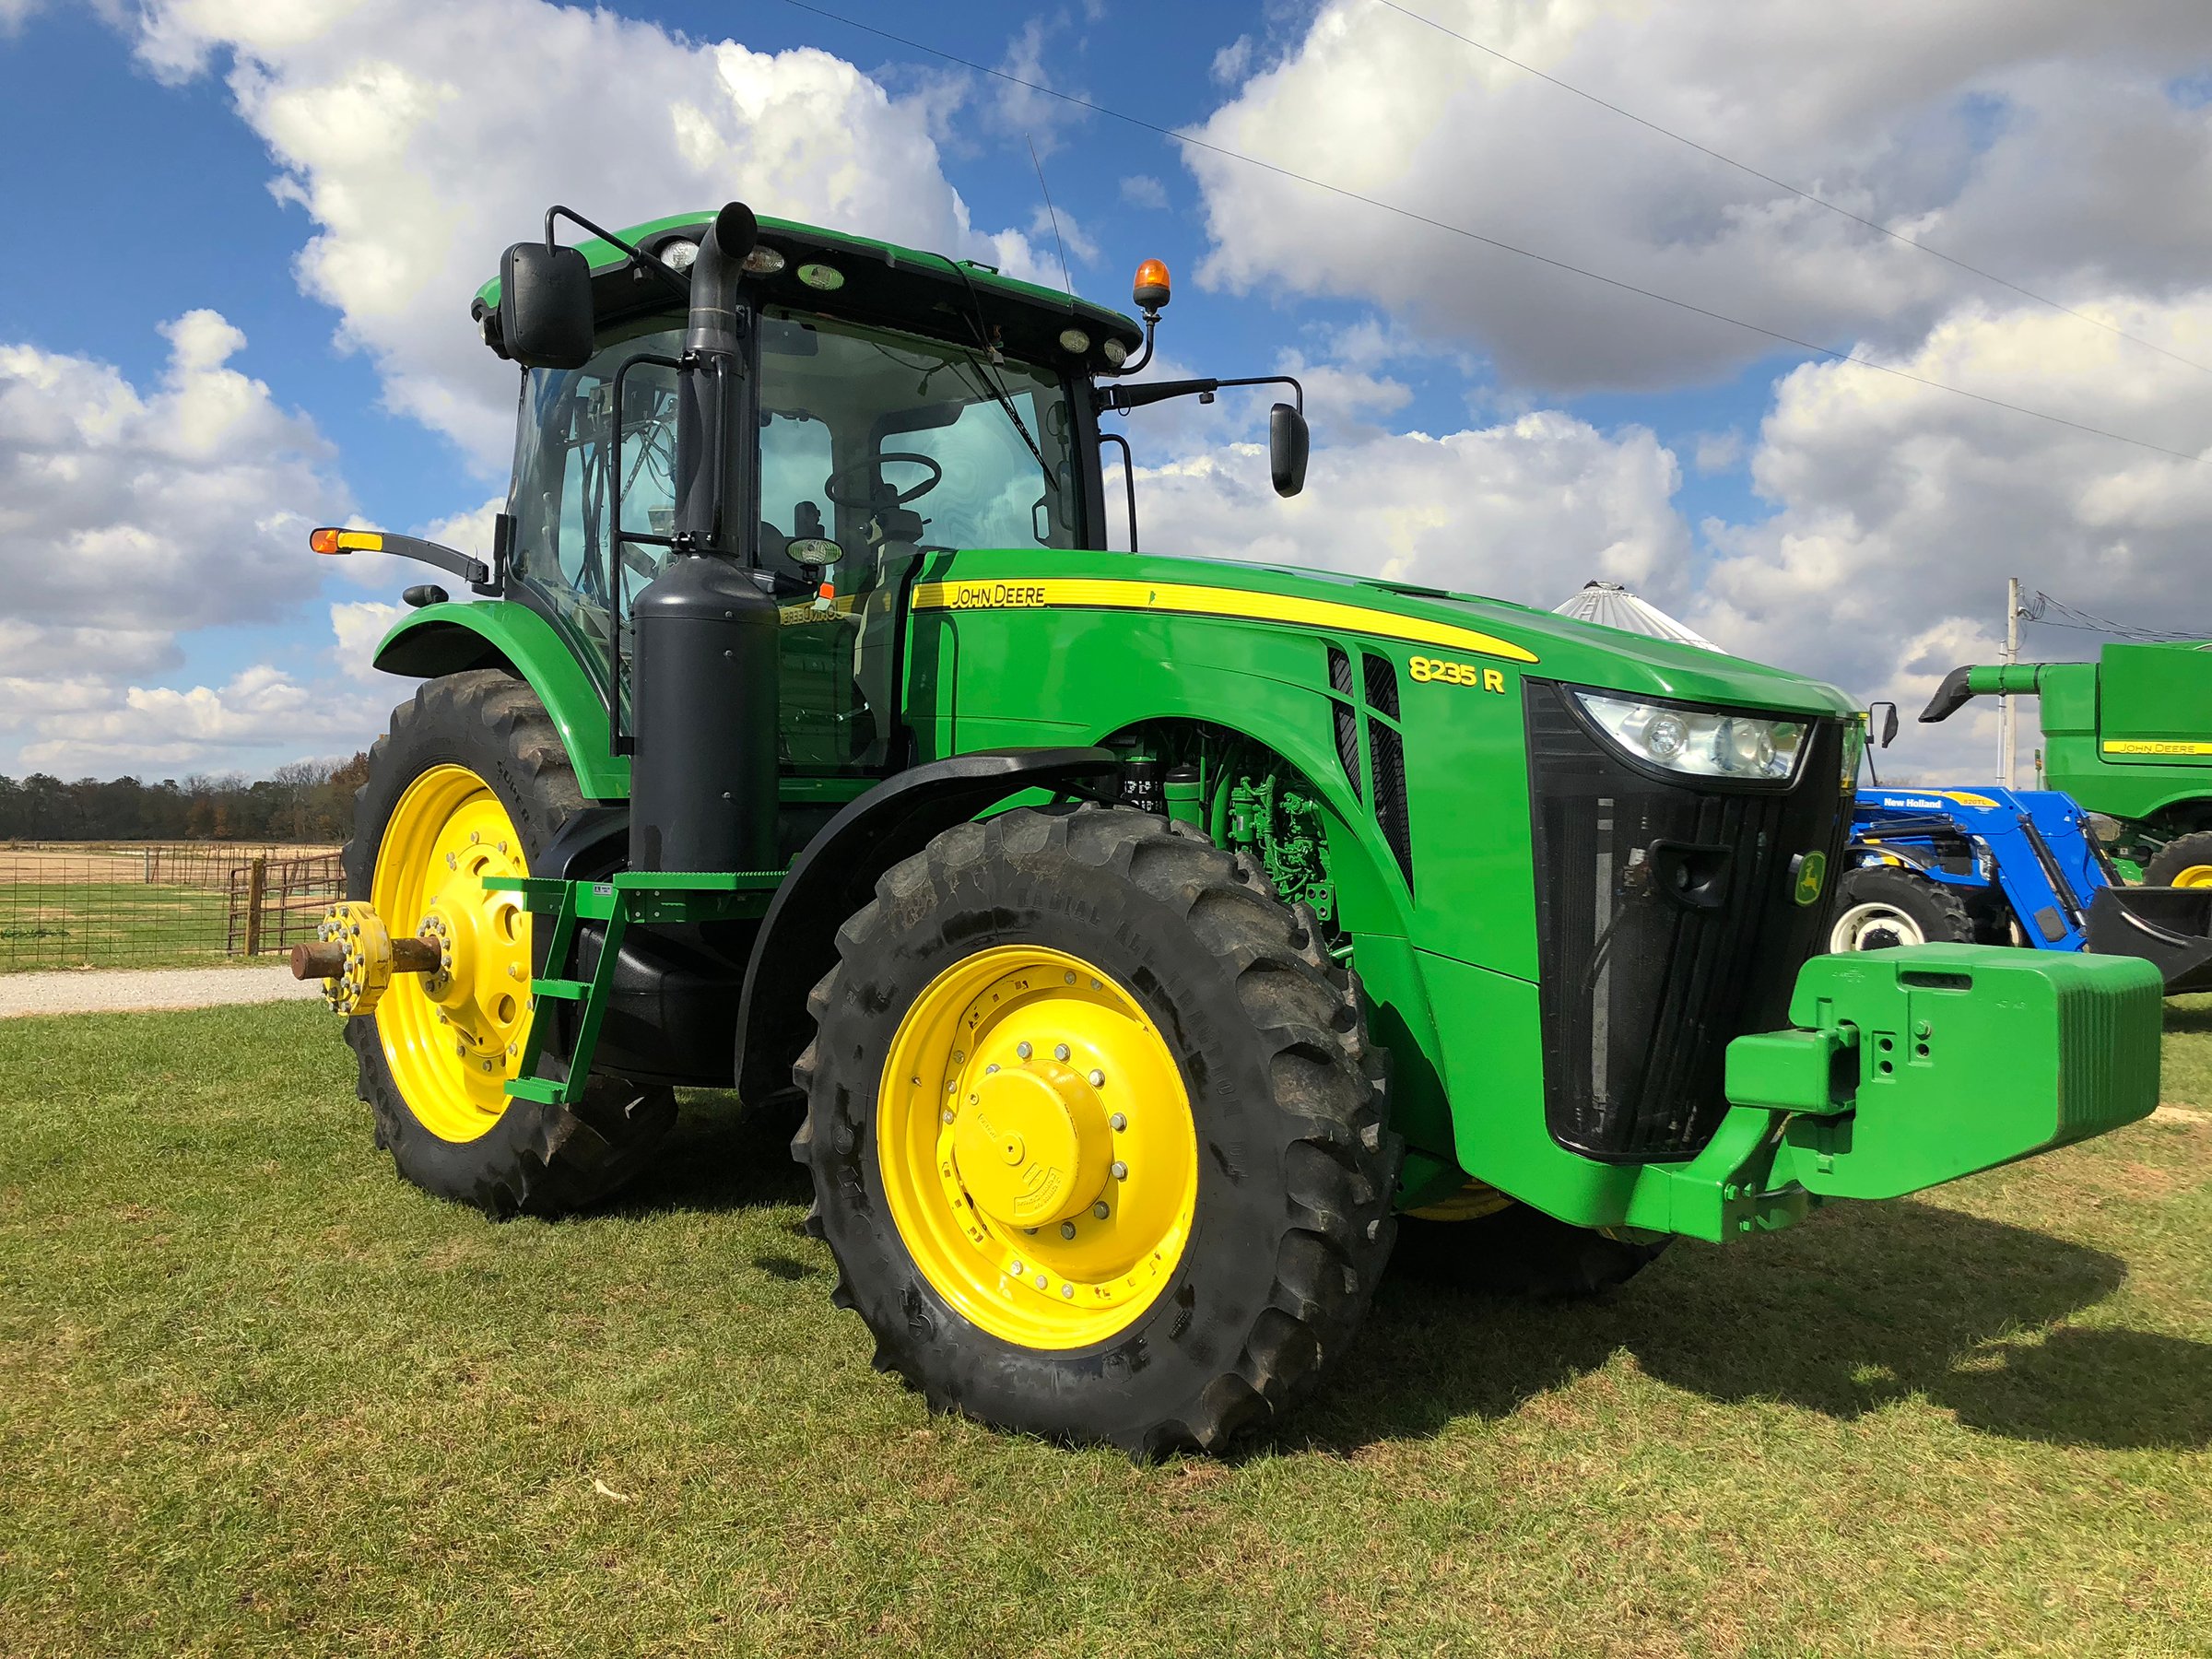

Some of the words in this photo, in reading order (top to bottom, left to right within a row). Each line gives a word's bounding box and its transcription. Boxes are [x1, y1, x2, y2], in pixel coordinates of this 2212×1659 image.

[951, 585, 992, 606] JOHN
[994, 583, 1046, 605] DEERE
[1408, 655, 1477, 687] 8235
[1482, 667, 1506, 695] R
[2119, 743, 2153, 752] JOHN
[2155, 744, 2196, 753] DEERE
[1884, 797, 1905, 807] New
[1906, 798, 1943, 809] Holland
